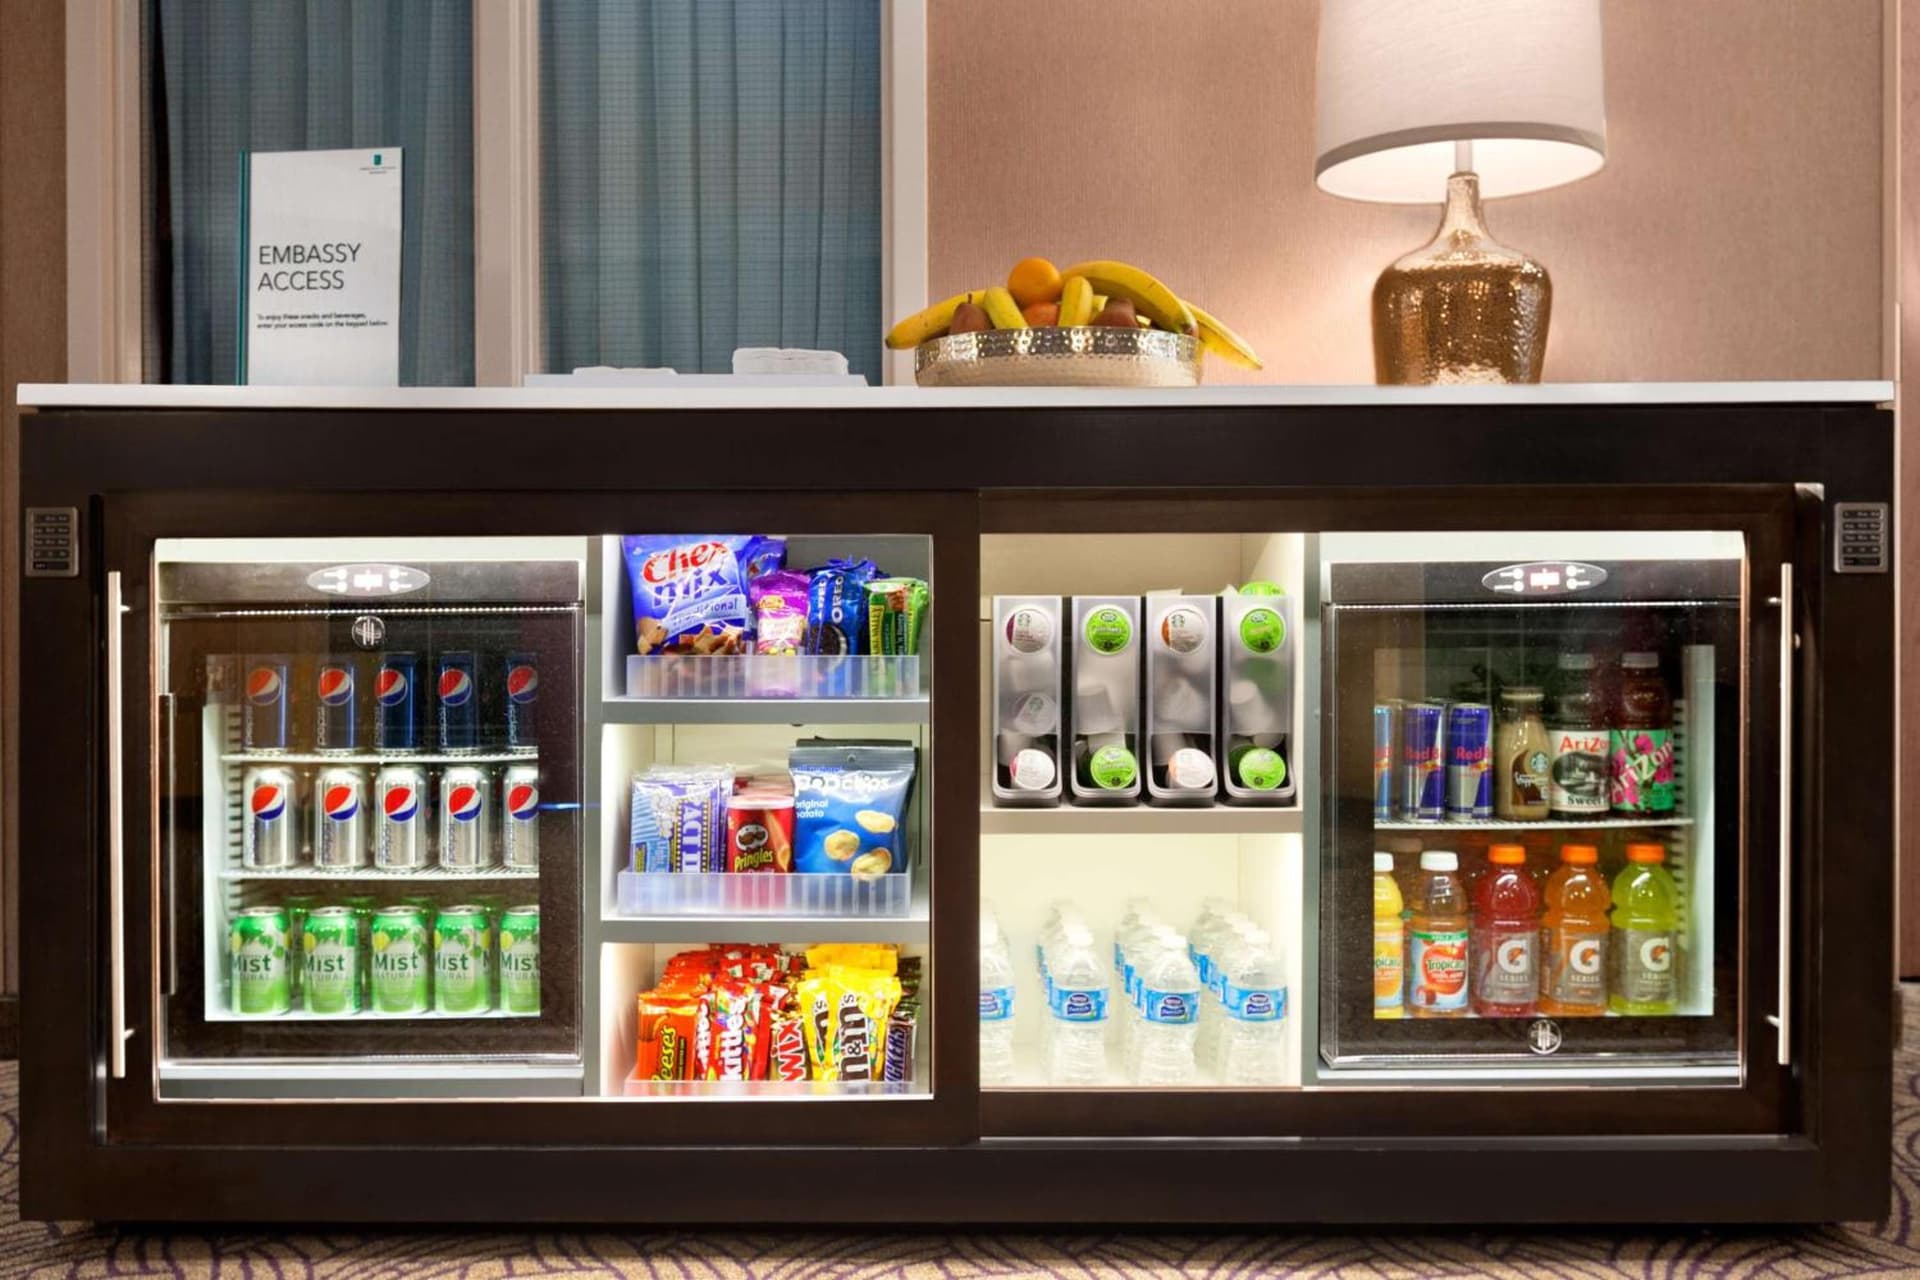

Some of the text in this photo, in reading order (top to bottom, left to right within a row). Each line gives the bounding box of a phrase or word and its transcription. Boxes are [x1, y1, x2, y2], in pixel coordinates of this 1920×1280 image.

[259, 243, 361, 265] EMBASSY
[258, 270, 345, 291] ACCESS
[642, 541, 728, 583] Chex
[831, 575, 843, 624] OREO
[1405, 746, 1430, 759] Red
[1456, 746, 1484, 760] Red
[681, 806, 702, 847] ACT
[734, 849, 774, 873] Pringles
[374, 952, 419, 971] Mist
[1497, 940, 1528, 974] G
[1570, 940, 1600, 974] G
[1640, 937, 1670, 971] G
[720, 998, 748, 1081] kittles
